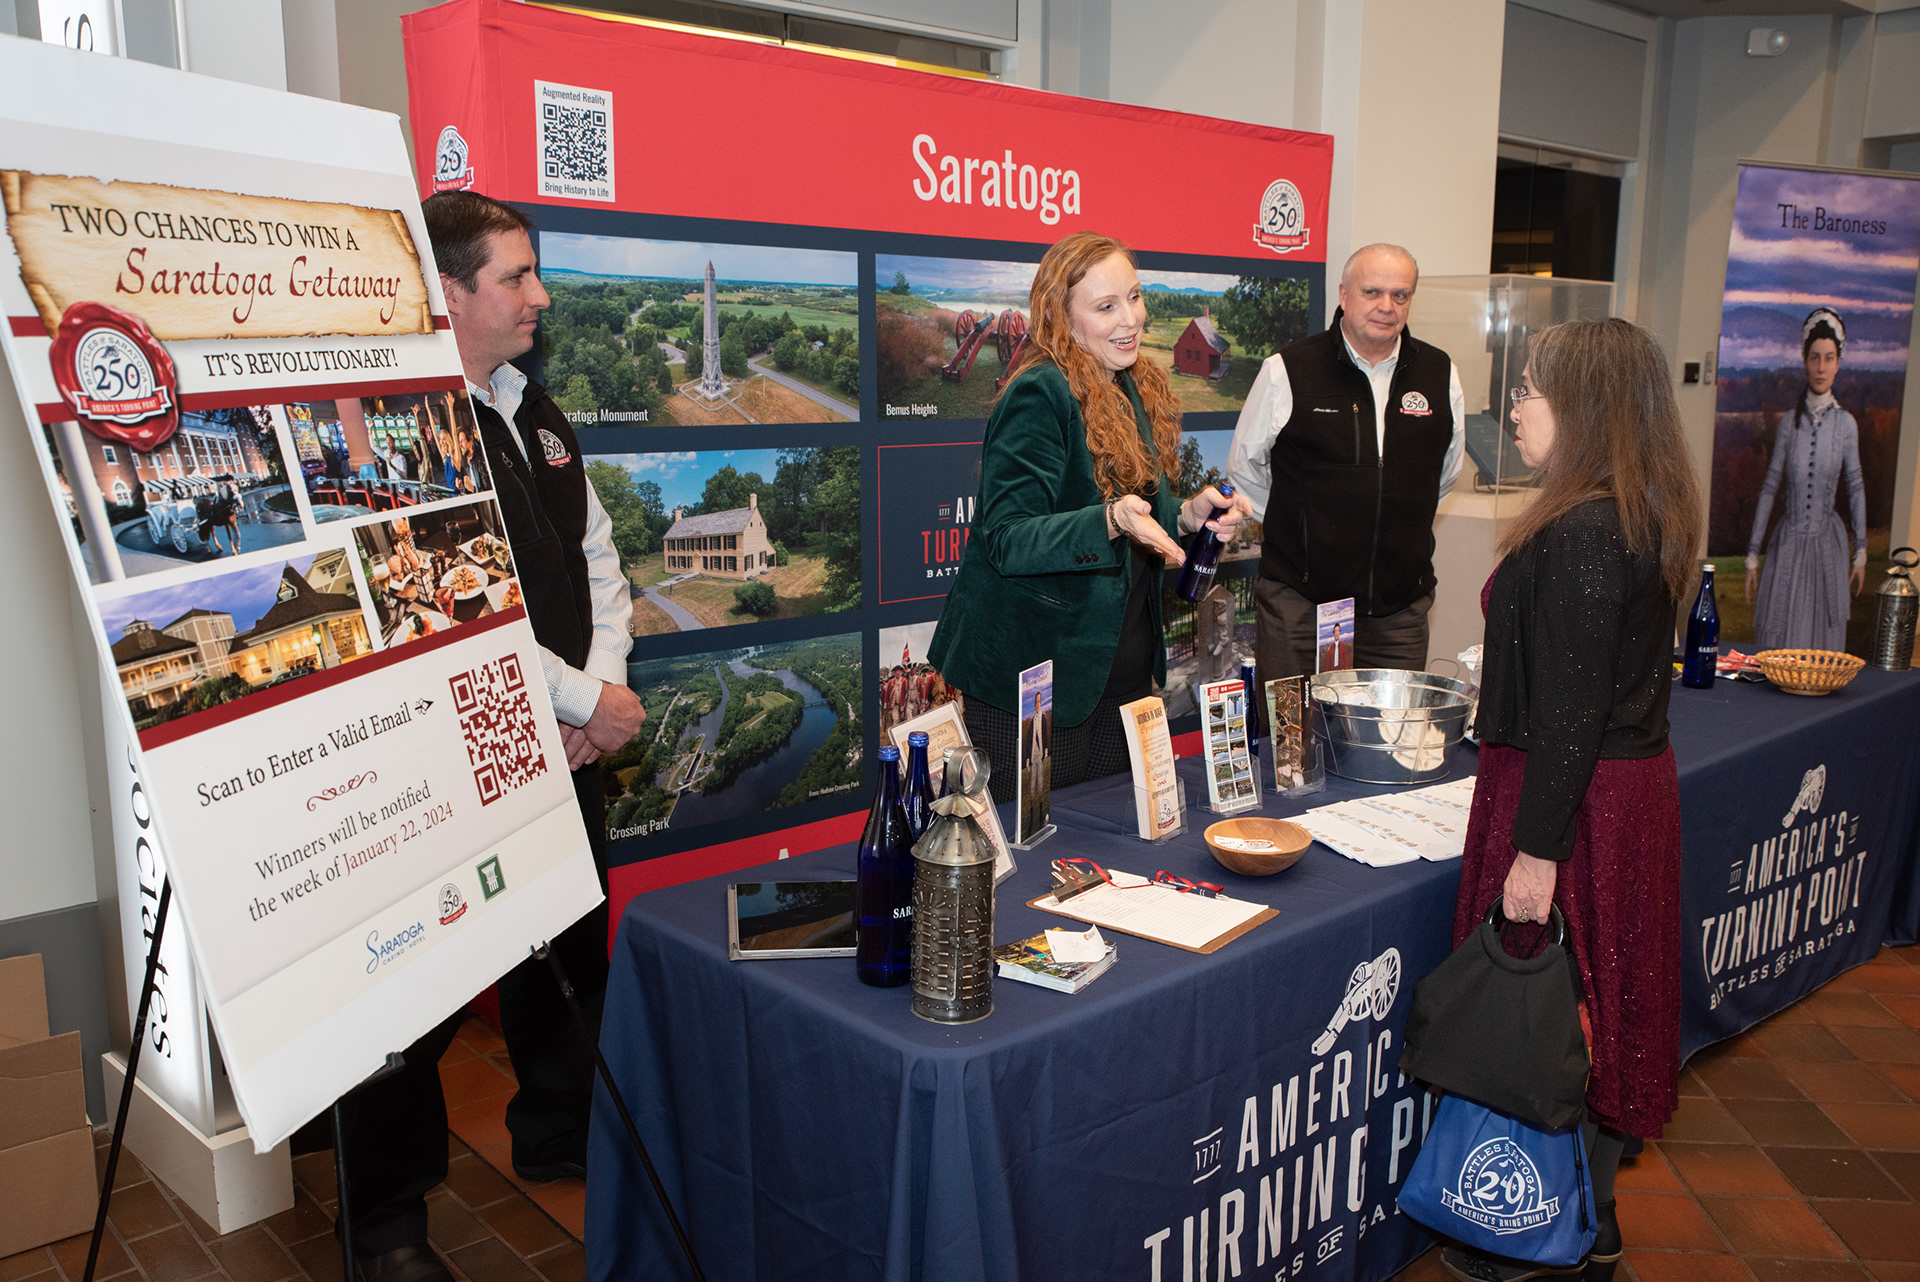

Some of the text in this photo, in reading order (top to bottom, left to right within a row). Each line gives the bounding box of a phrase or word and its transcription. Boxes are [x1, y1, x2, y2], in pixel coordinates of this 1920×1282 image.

[543, 87, 606, 106] Augmented Reality
[545, 183, 609, 197] Bring History to Life
[912, 133, 1081, 225] Saratoga
[51, 203, 360, 250] TWO CHANCES TO WIN A
[1268, 203, 1297, 232] 250
[1777, 203, 1886, 235] The Baroness
[116, 247, 401, 325] Saratoga Getaway
[82, 339, 99, 386] BATTLES
[108, 336, 148, 383] SARATOGA
[203, 348, 399, 376] IT'S REVOLUTIONARY!
[93, 358, 140, 398] 250
[91, 400, 157, 412] AMERICA'S TURNING POINT
[600, 408, 649, 422] Monument
[886, 403, 938, 418] Bemus Heights
[1406, 399, 1425, 410] 250
[938, 508, 950, 516] 1777
[197, 701, 412, 807] Scan to Enter a Valid Email
[255, 779, 431, 880] Winners will be notified
[610, 815, 670, 840] Crossing Park
[249, 801, 453, 922] the week of January 22, 2024
[1744, 811, 1848, 895] AMERICA'S
[443, 893, 459, 914] 250
[893, 905, 914, 919] SAR
[1701, 851, 1867, 983] TURNING POINT
[366, 922, 425, 974] SARATOGA
[382, 935, 426, 966] CASINO HOTEL
[1709, 963, 1770, 1011] BATTLES
[1195, 1029, 1405, 1173] 1777 AMERIC
[1464, 1143, 1502, 1189] BATTLES
[1144, 1123, 1369, 1282] TURNING
[1457, 1206, 1544, 1228] AMERICA'S RNING POINT
[1317, 1231, 1343, 1259] OF
